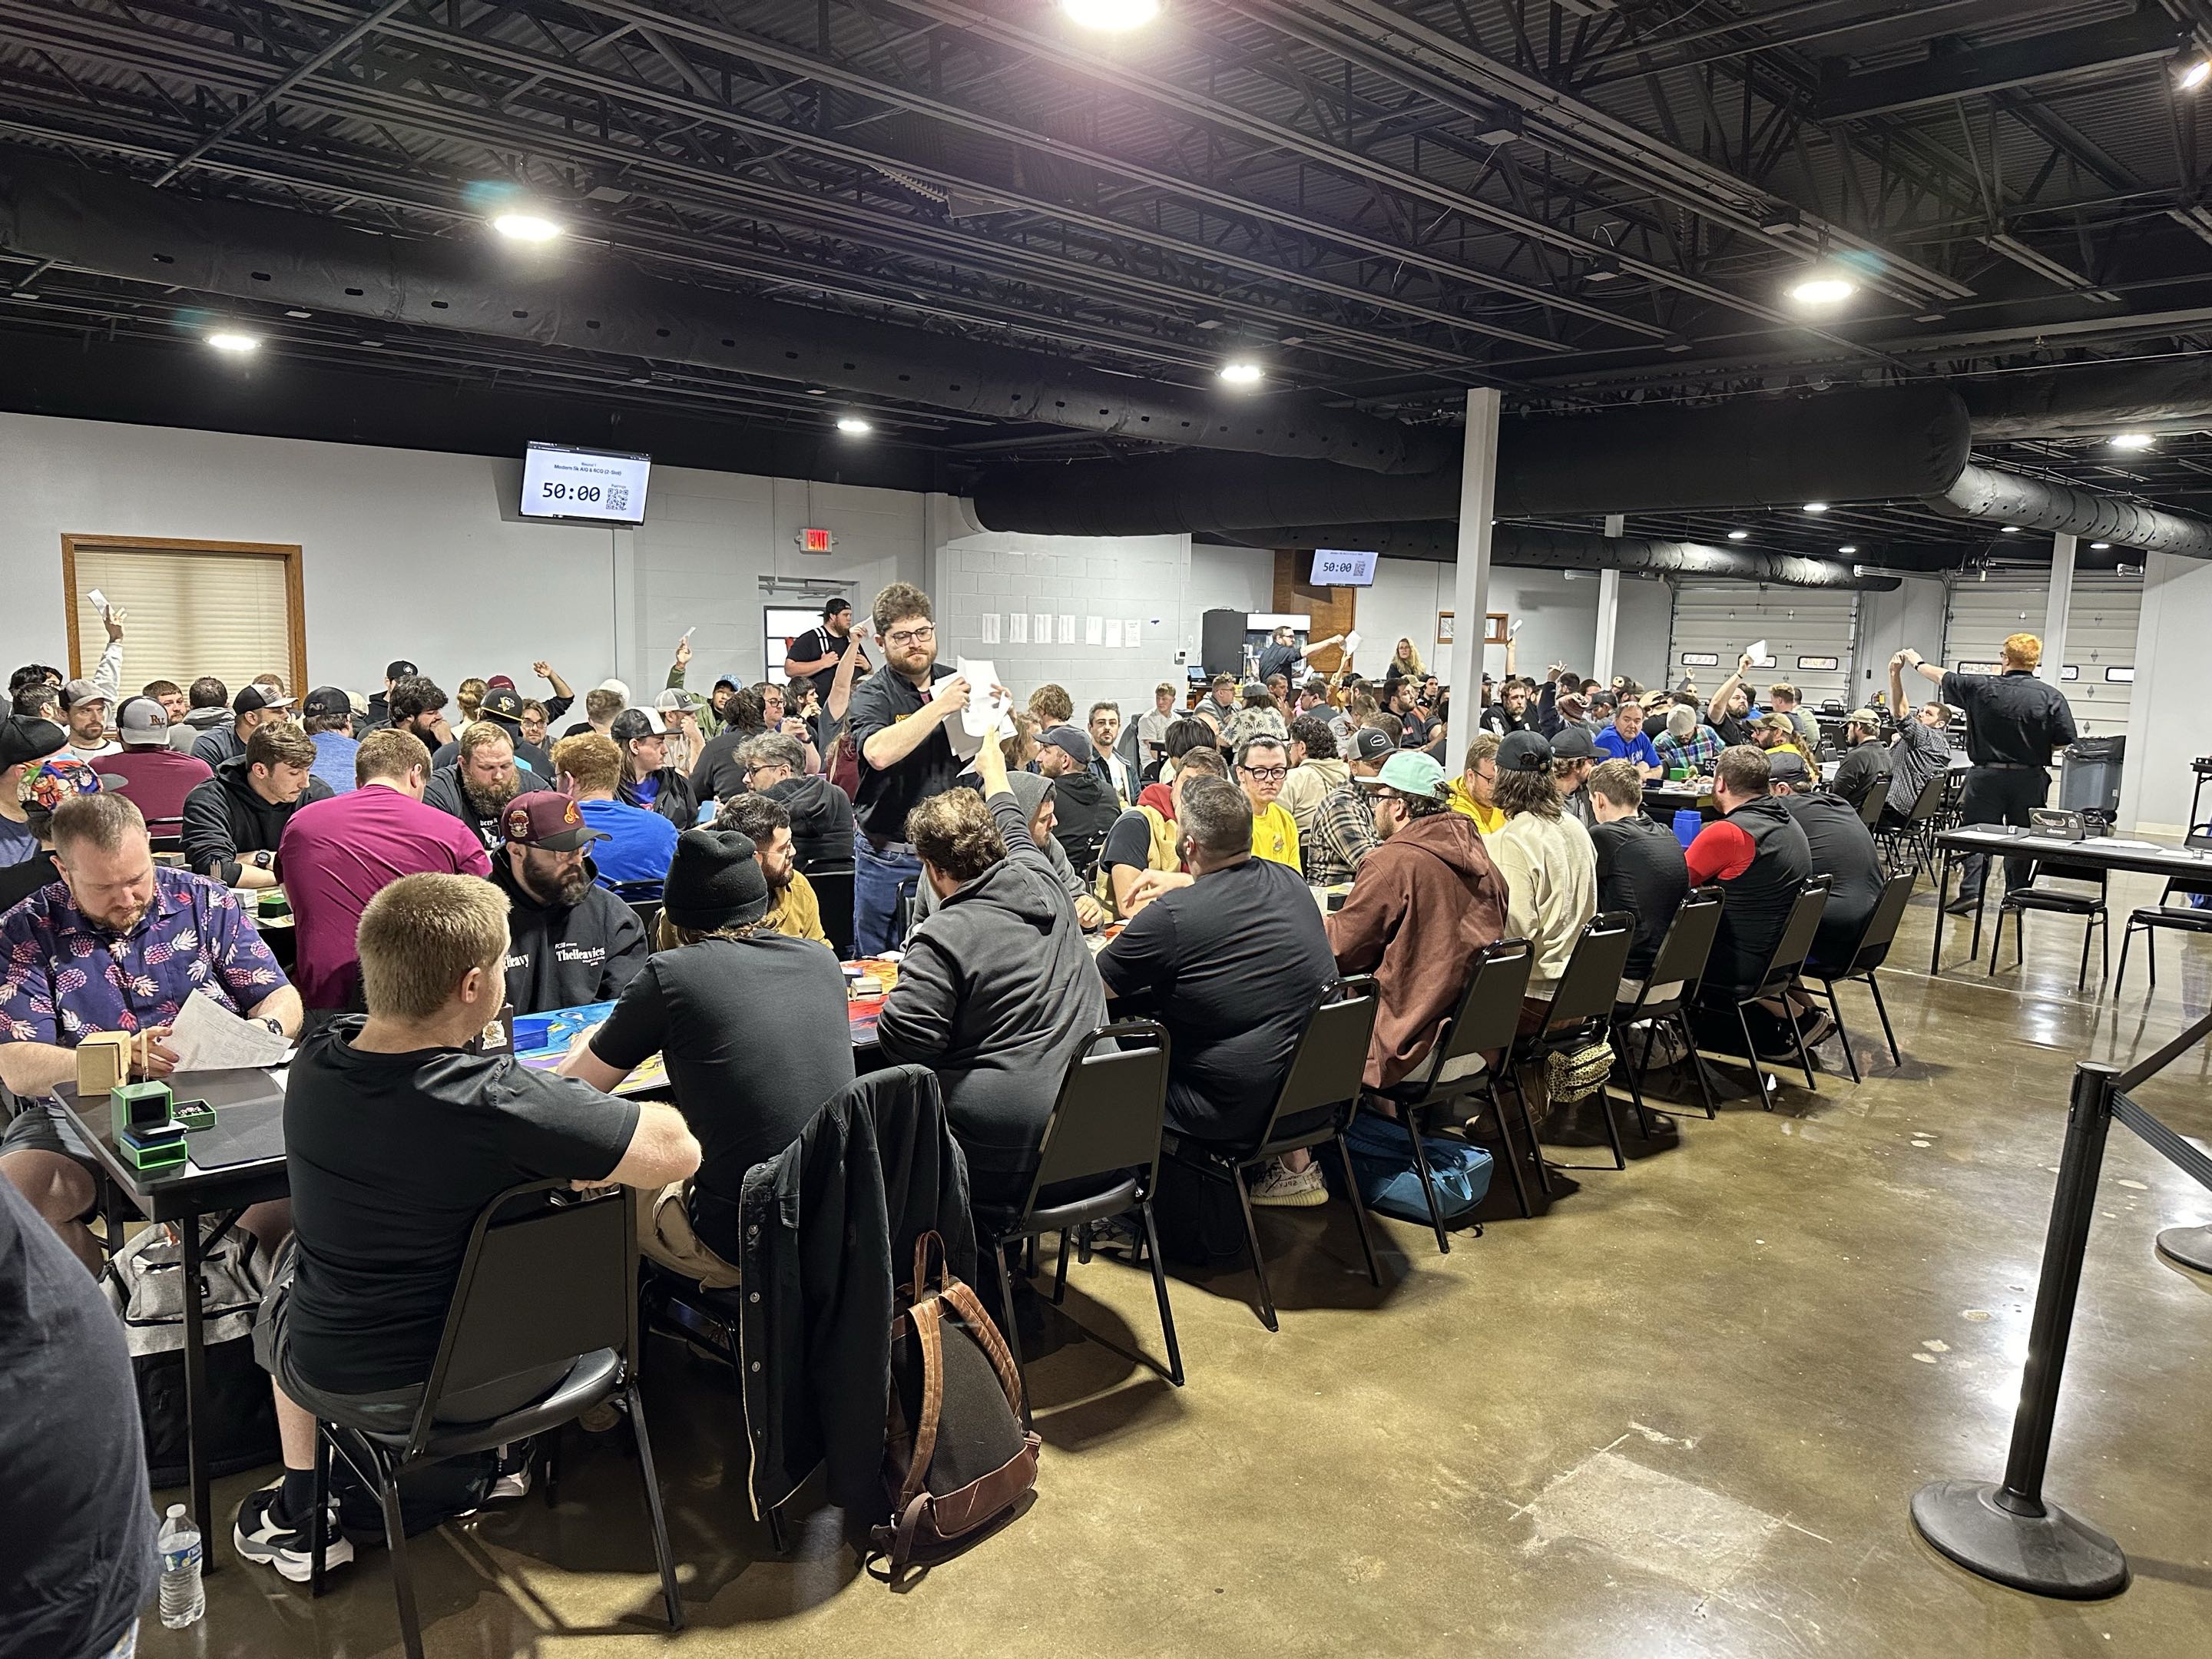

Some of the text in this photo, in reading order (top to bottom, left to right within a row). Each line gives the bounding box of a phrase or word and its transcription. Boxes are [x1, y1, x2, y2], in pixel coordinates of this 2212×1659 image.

[542, 482, 601, 502] 50:00
[807, 529, 829, 551] EXIT
[1323, 562, 1352, 572] 50:00
[1705, 760, 1716, 770] 55
